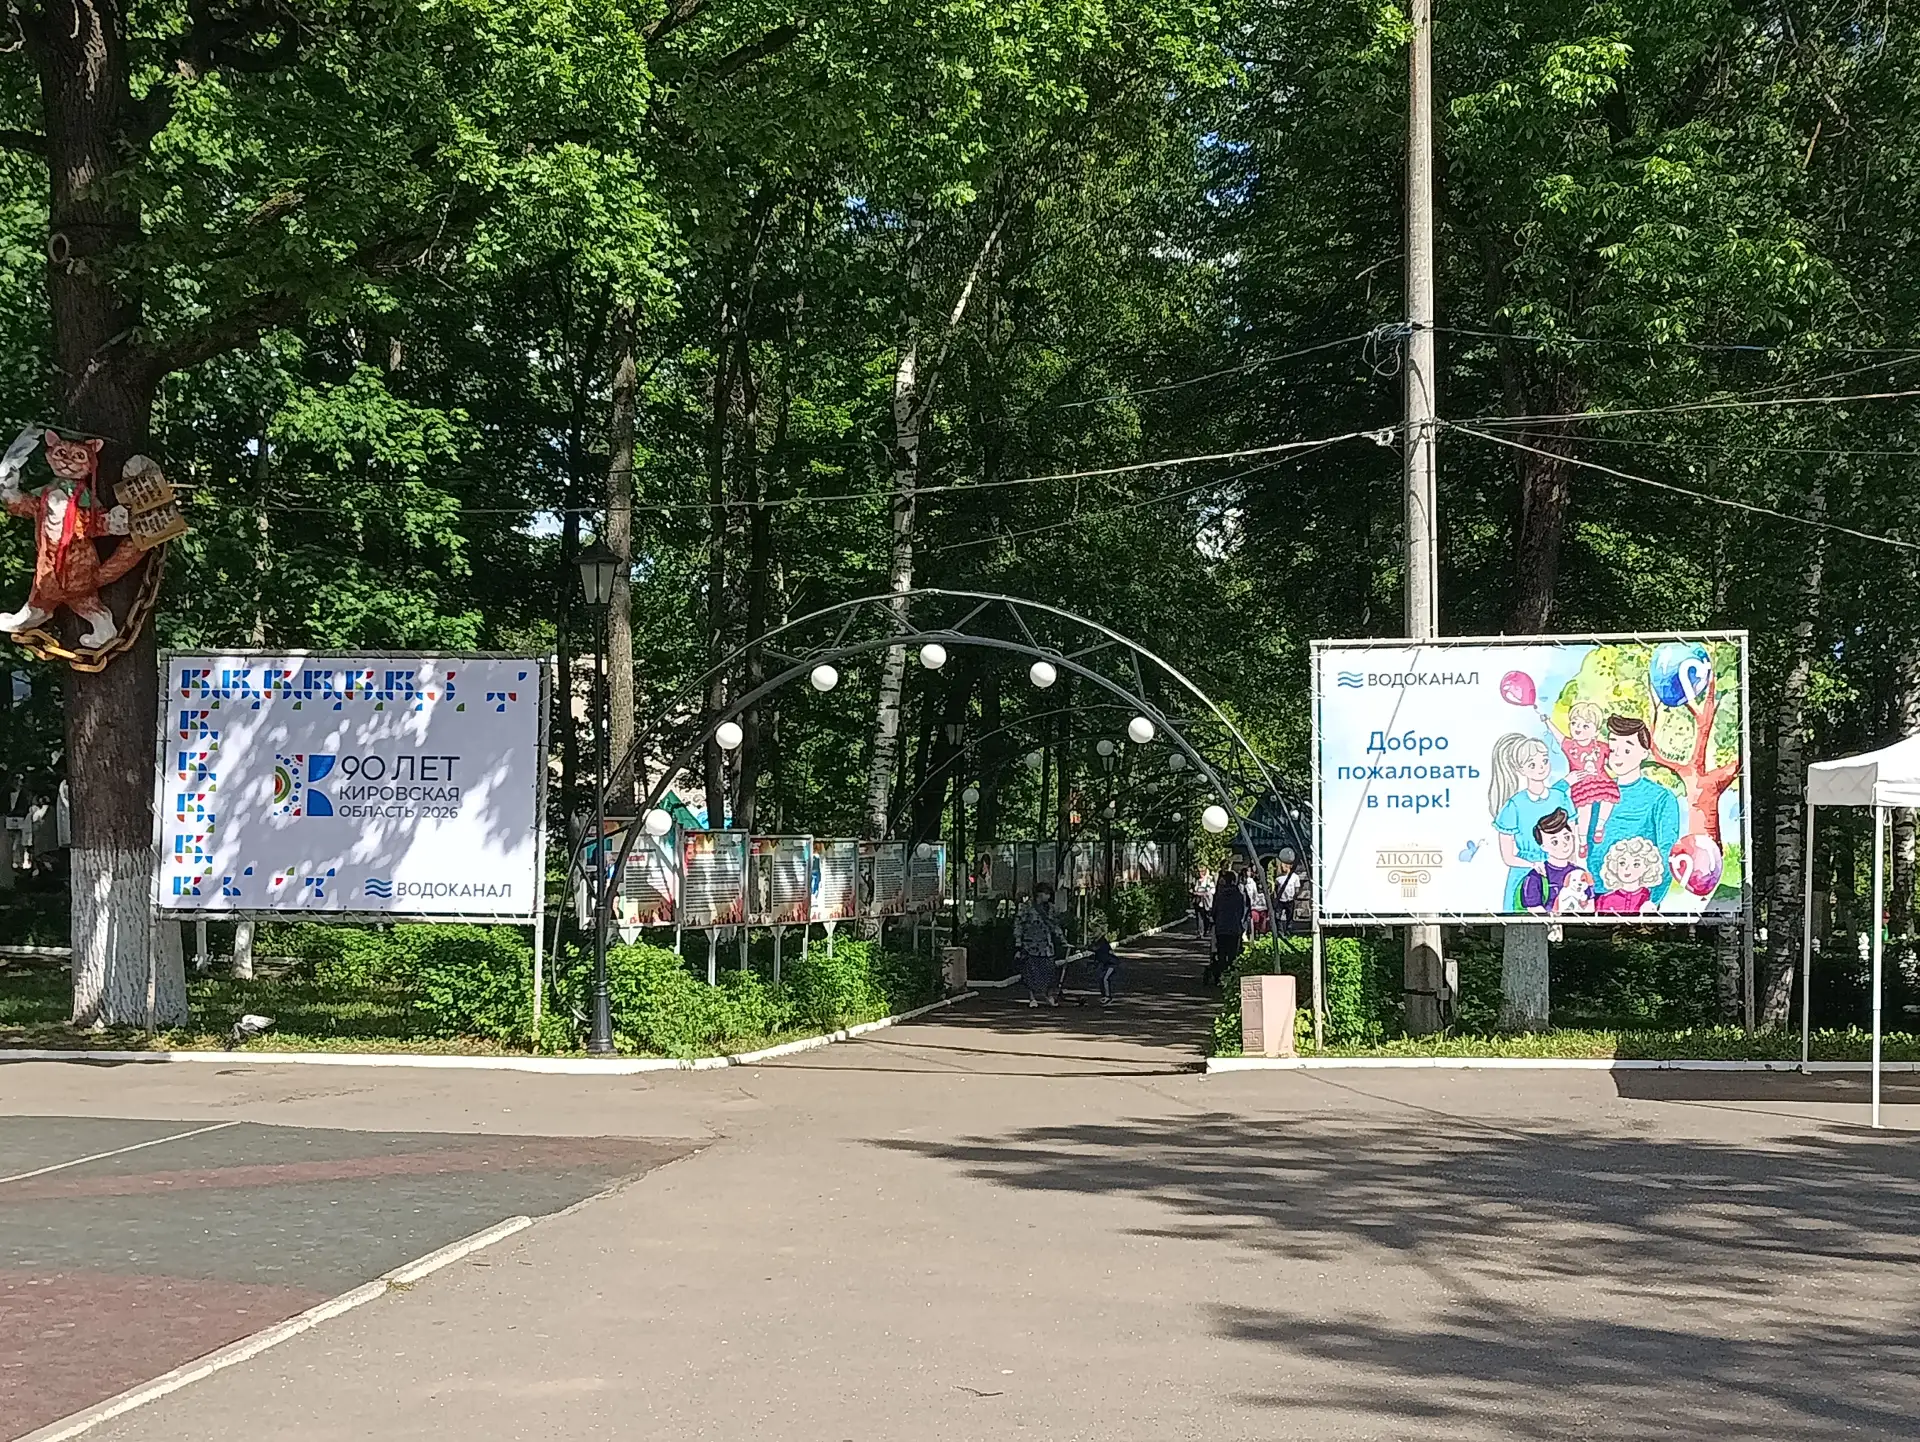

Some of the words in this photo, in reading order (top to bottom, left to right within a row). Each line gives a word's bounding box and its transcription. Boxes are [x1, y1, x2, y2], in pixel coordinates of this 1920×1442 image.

[1368, 671, 1479, 688] ВОДОКАНАЛ
[1366, 729, 1449, 756] Добро
[341, 755, 386, 781] 90
[391, 755, 460, 781] ЛЕТ
[1338, 765, 1480, 780] пожаловать
[339, 785, 459, 801] КИРОВСКАЯ
[1367, 795, 1379, 808] в
[1387, 788, 1450, 814] парк!
[339, 805, 415, 818] ОБЛАСТЬ
[422, 806, 458, 819] 2026
[1376, 853, 1443, 865] АПОЛЛО
[396, 882, 511, 899] ВОДОКАНАЛ
